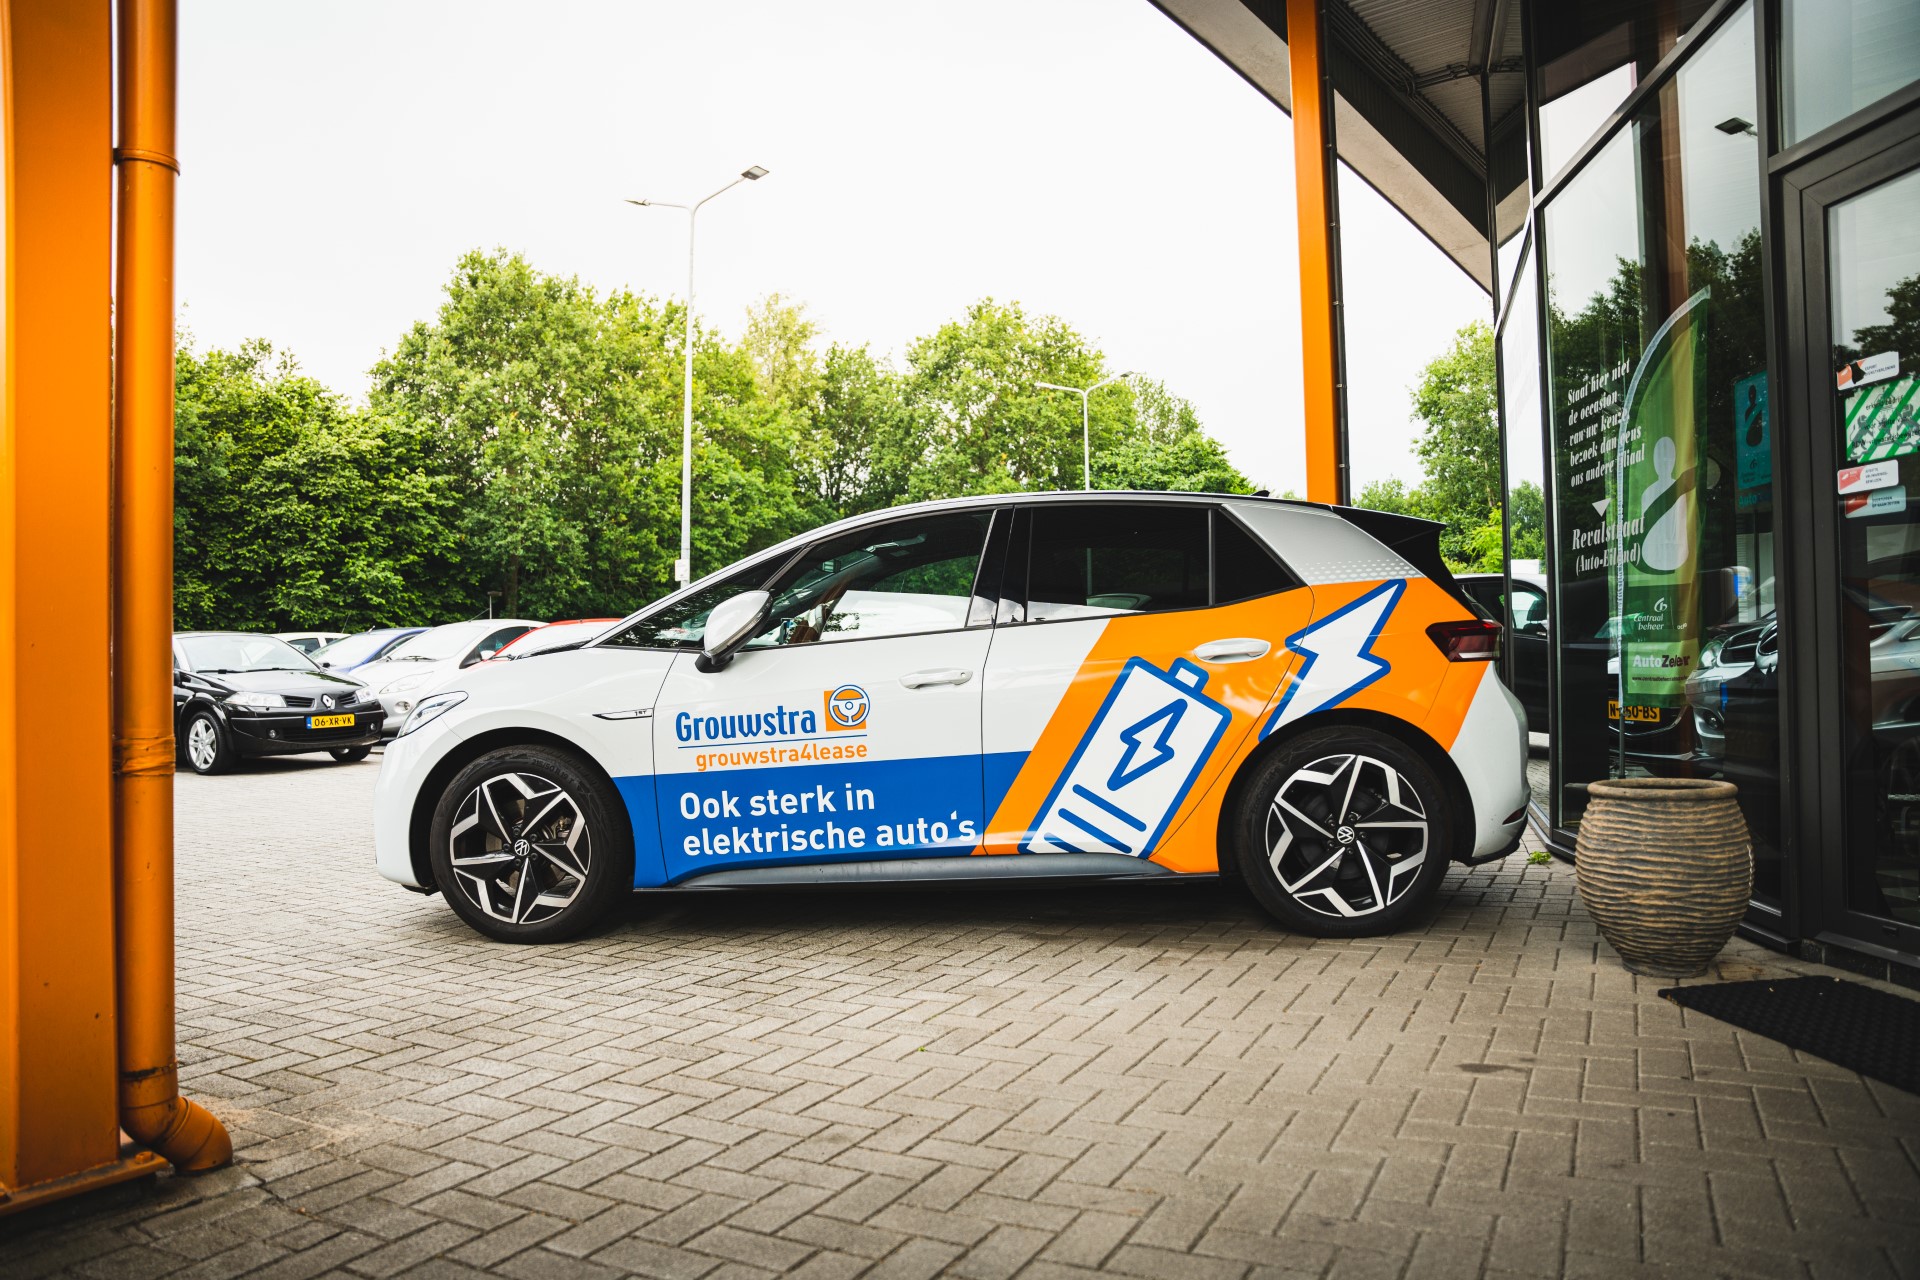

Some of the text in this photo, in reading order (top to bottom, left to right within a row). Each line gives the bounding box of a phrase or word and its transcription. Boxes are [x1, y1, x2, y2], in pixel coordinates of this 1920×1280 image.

[1567, 359, 1630, 406] Staat hier niet
[1568, 390, 1618, 426] de occasion
[1569, 428, 1584, 447] van
[1586, 422, 1599, 437] uw
[1569, 424, 1642, 467] bezoek dan eens
[1570, 442, 1646, 488] ons andere liaal
[1633, 612, 1664, 622] Centraal
[314, 716, 352, 727] 06-XR-VK
[675, 705, 817, 742] Grouwstra
[1609, 703, 1658, 720] N-50-BS
[696, 743, 868, 772] grouwstra4lease
[679, 782, 875, 820] Ook sterk in
[683, 810, 977, 856] elektrische auto's
